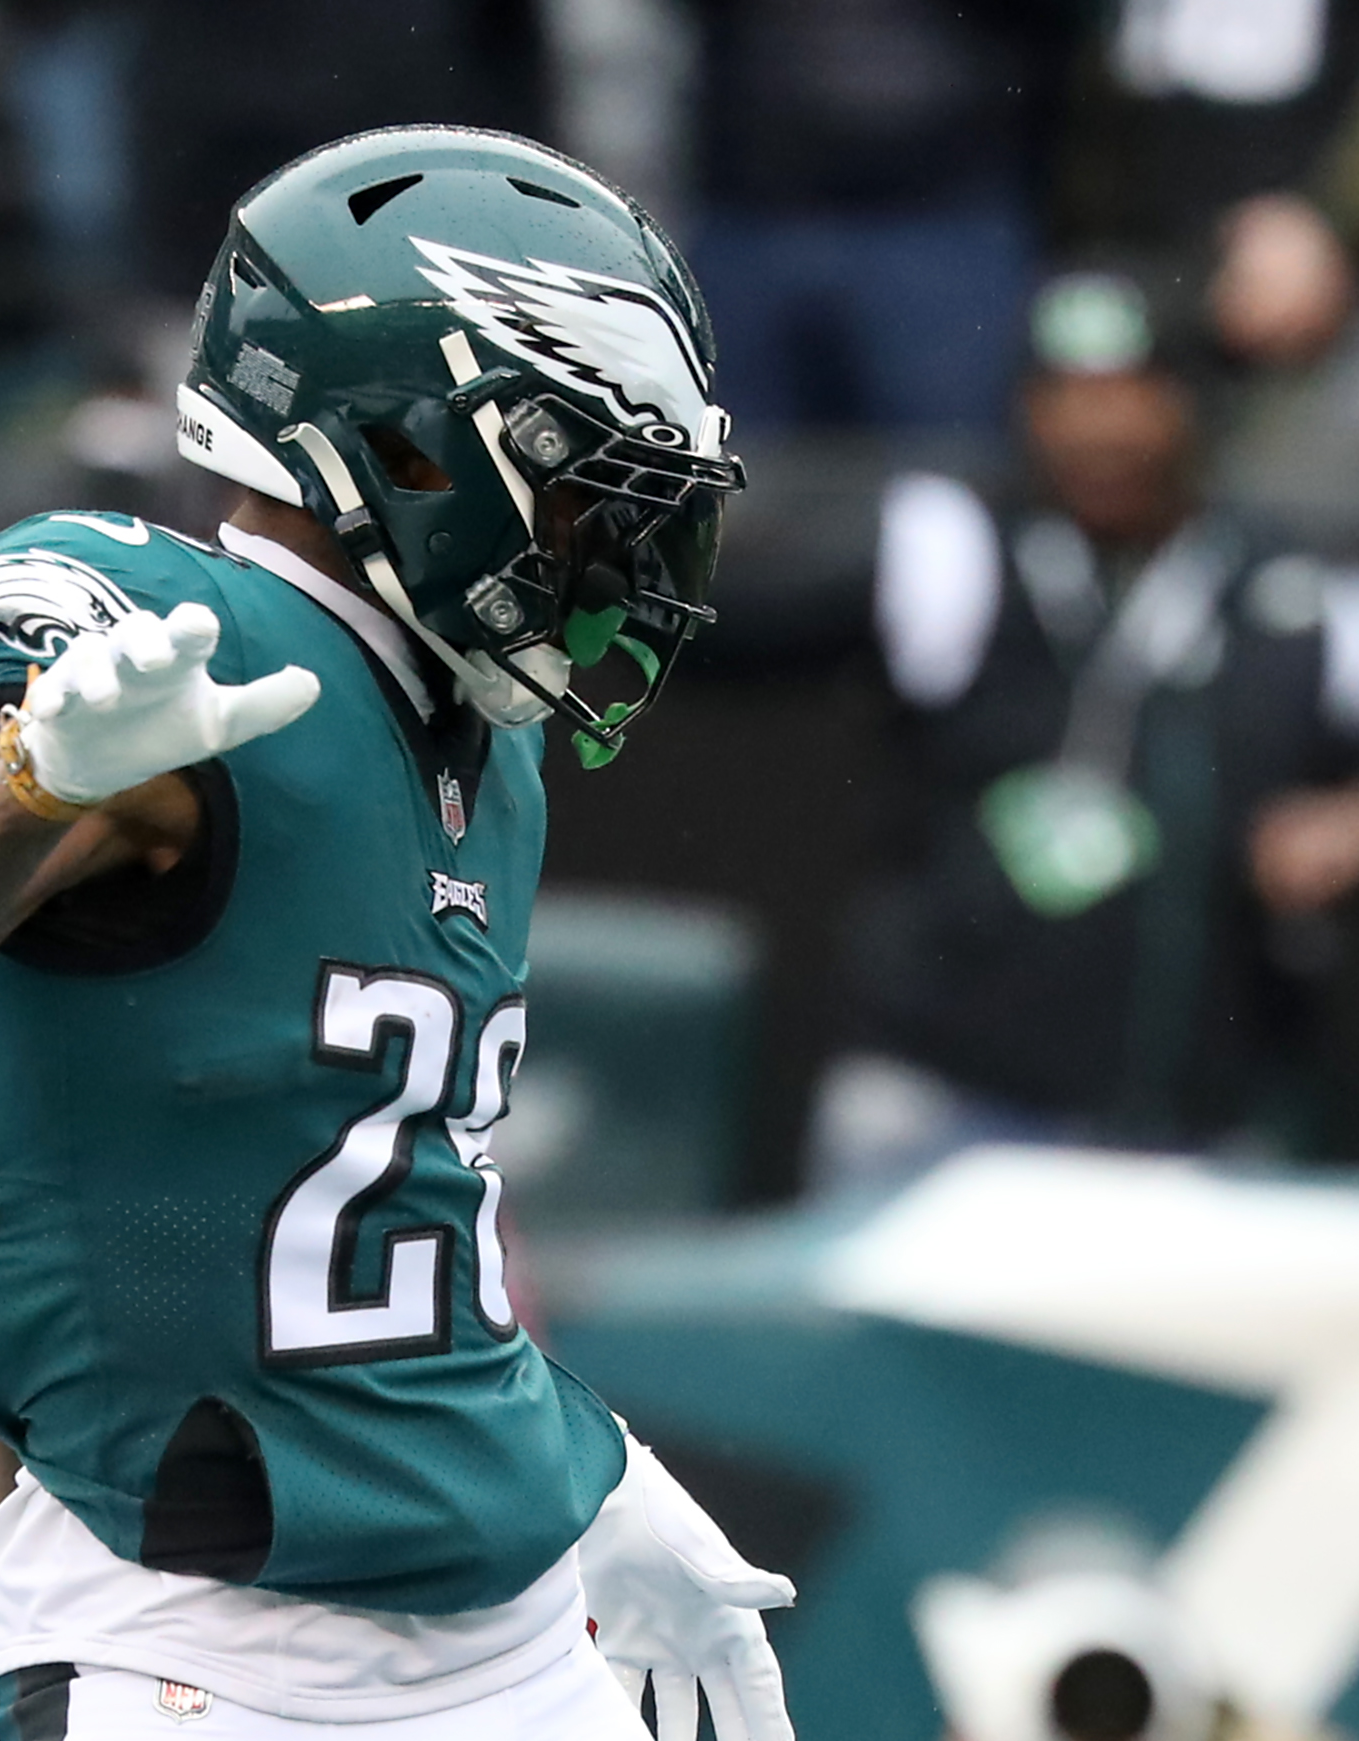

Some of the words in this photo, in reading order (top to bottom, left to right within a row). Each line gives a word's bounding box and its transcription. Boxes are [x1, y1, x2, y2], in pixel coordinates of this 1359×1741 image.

[177, 413, 213, 452] ANGE
[428, 868, 489, 927] EAGLES
[163, 1680, 203, 1710] NFL
